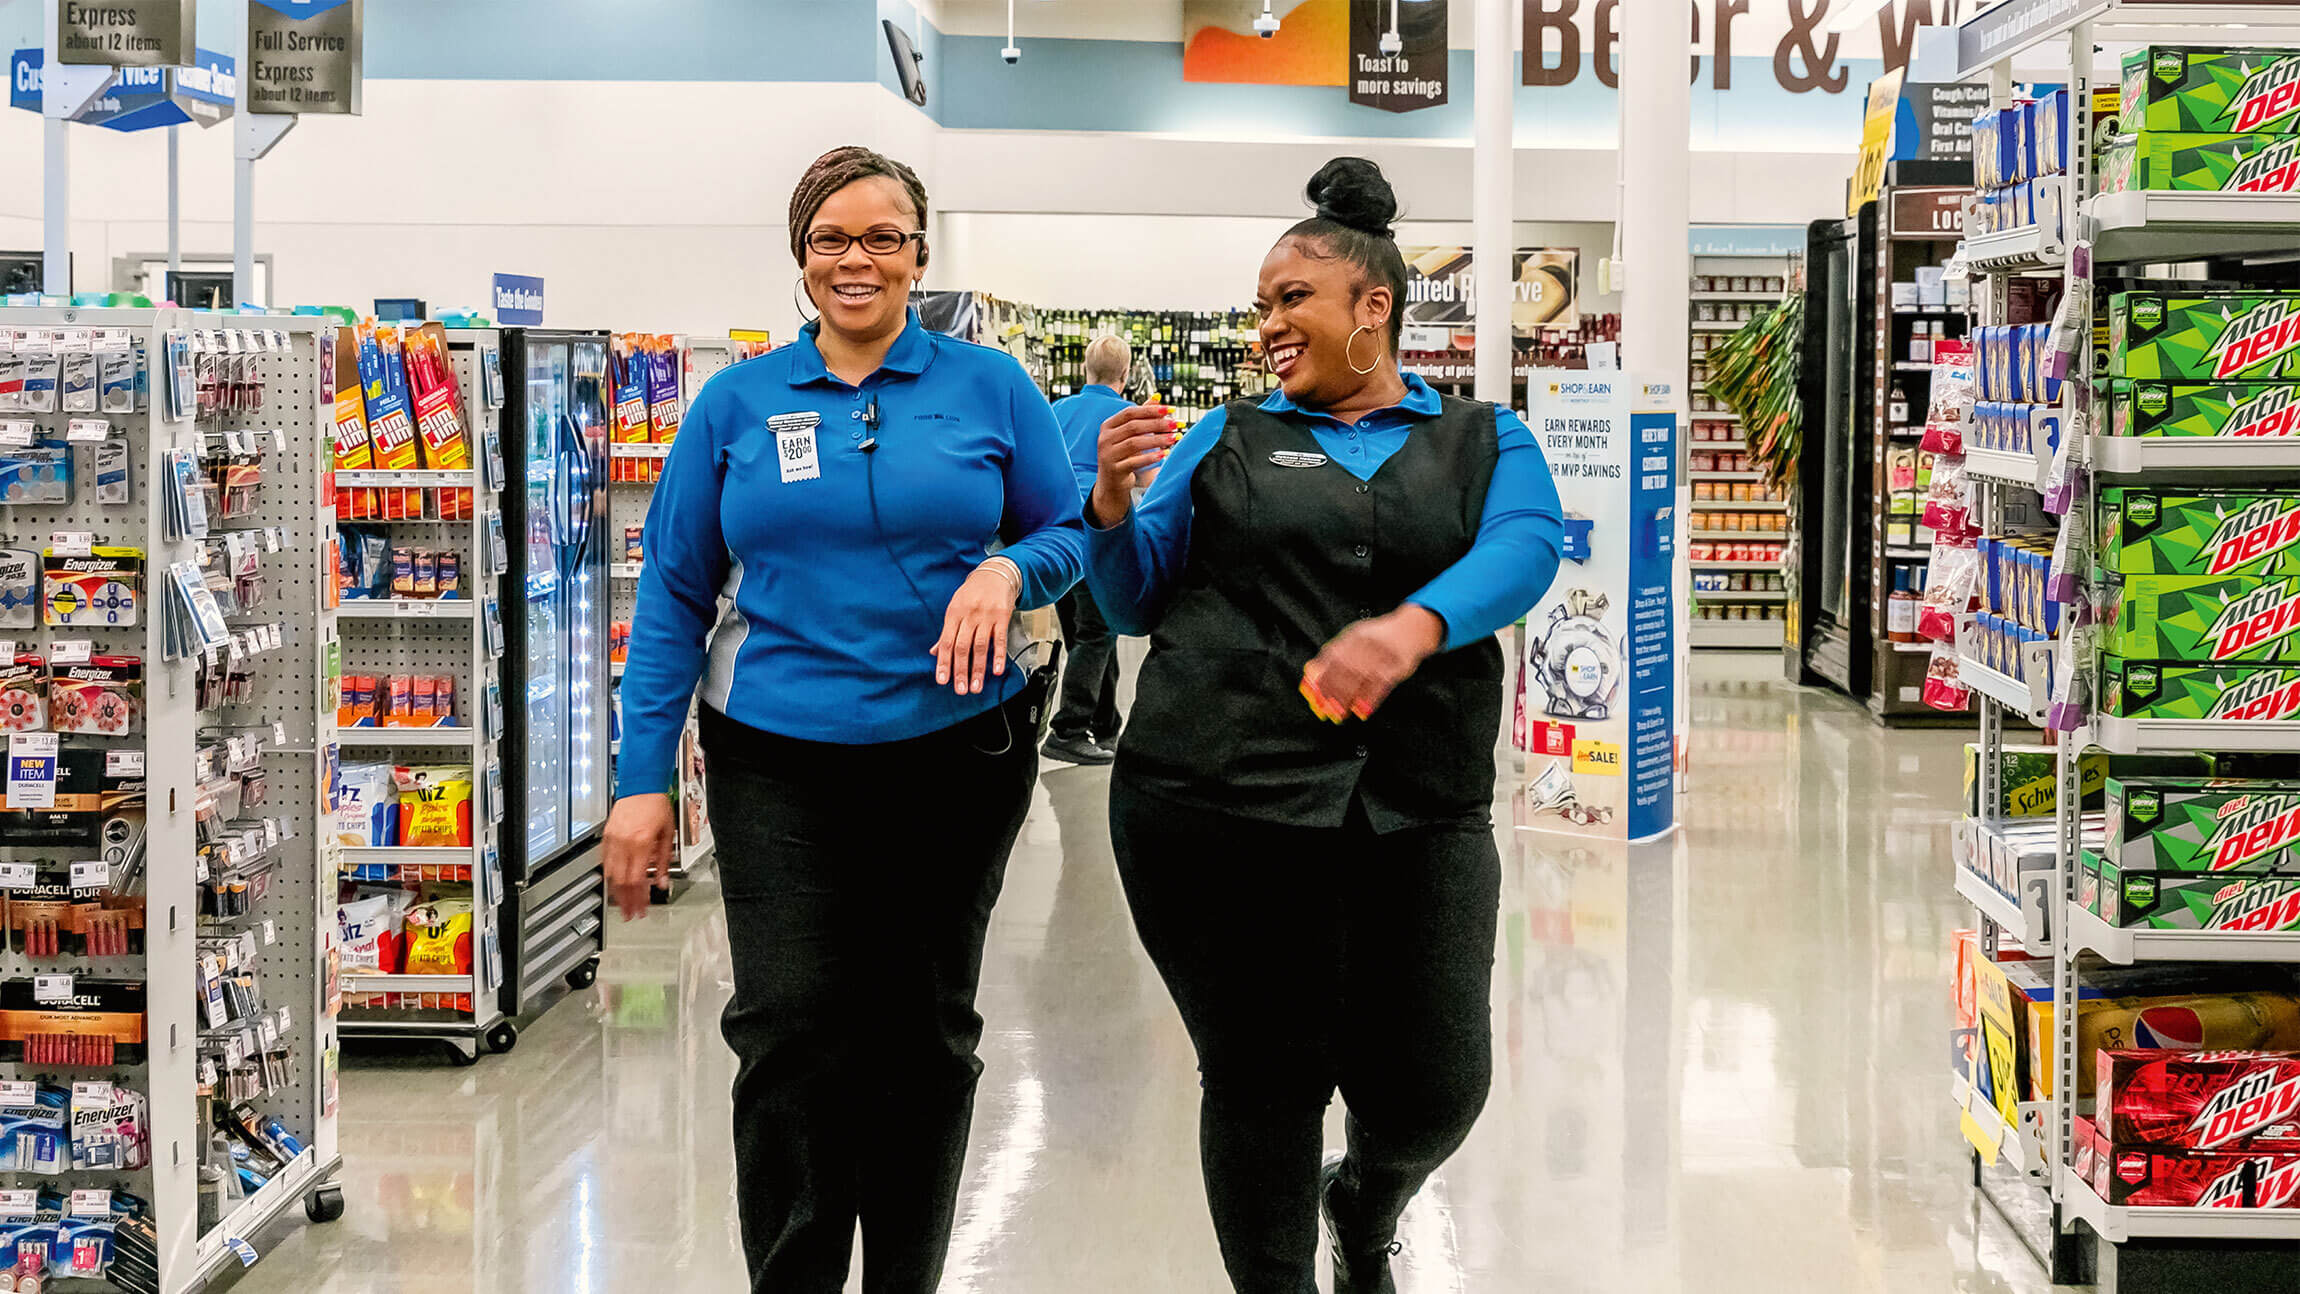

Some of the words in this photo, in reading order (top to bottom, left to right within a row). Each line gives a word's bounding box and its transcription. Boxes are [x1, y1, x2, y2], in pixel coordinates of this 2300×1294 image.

[67, 2, 136, 30] Express
[66, 36, 103, 50] about
[108, 34, 122, 50] 12
[126, 34, 162, 51] items
[255, 30, 282, 51] Full
[288, 31, 345, 51] Service
[1522, 0, 1750, 90] Ber
[255, 61, 314, 85] Express
[1357, 54, 1393, 73] Toast
[1395, 56, 1409, 73] to
[254, 87, 286, 101] about
[290, 87, 301, 102] 12
[305, 89, 337, 102] items
[1357, 78, 1390, 95] more
[1393, 77, 1442, 99] savings
[2235, 79, 2300, 132] De
[2227, 144, 2294, 190] Mtn
[1933, 211, 1962, 229] LOC
[1405, 273, 1455, 302] nited
[2217, 302, 2284, 351] Mtn
[2222, 389, 2290, 437] Mtn
[1545, 418, 1566, 432] EARN
[1568, 419, 1611, 433] REWARDS
[782, 436, 811, 450] EARN
[1547, 435, 1573, 448] EVERY
[1575, 435, 1608, 449] MONTH
[1561, 463, 1580, 476] MVP
[1582, 464, 1621, 479] SAVINGS
[2211, 501, 2278, 548] Mtn
[2216, 586, 2282, 633] Mtn
[2209, 672, 2277, 719] Mtn
[20, 759, 46, 769] NEW
[2005, 755, 2018, 765] 12
[20, 768, 45, 780] ITEM
[2219, 795, 2250, 817] diet
[2211, 799, 2280, 850] Mtn
[2215, 880, 2245, 904] diet
[2203, 884, 2278, 930] Mtn
[2203, 1073, 2271, 1120] Mtn
[74, 1103, 134, 1126] Energizer
[2203, 1081, 2297, 1145] Dew
